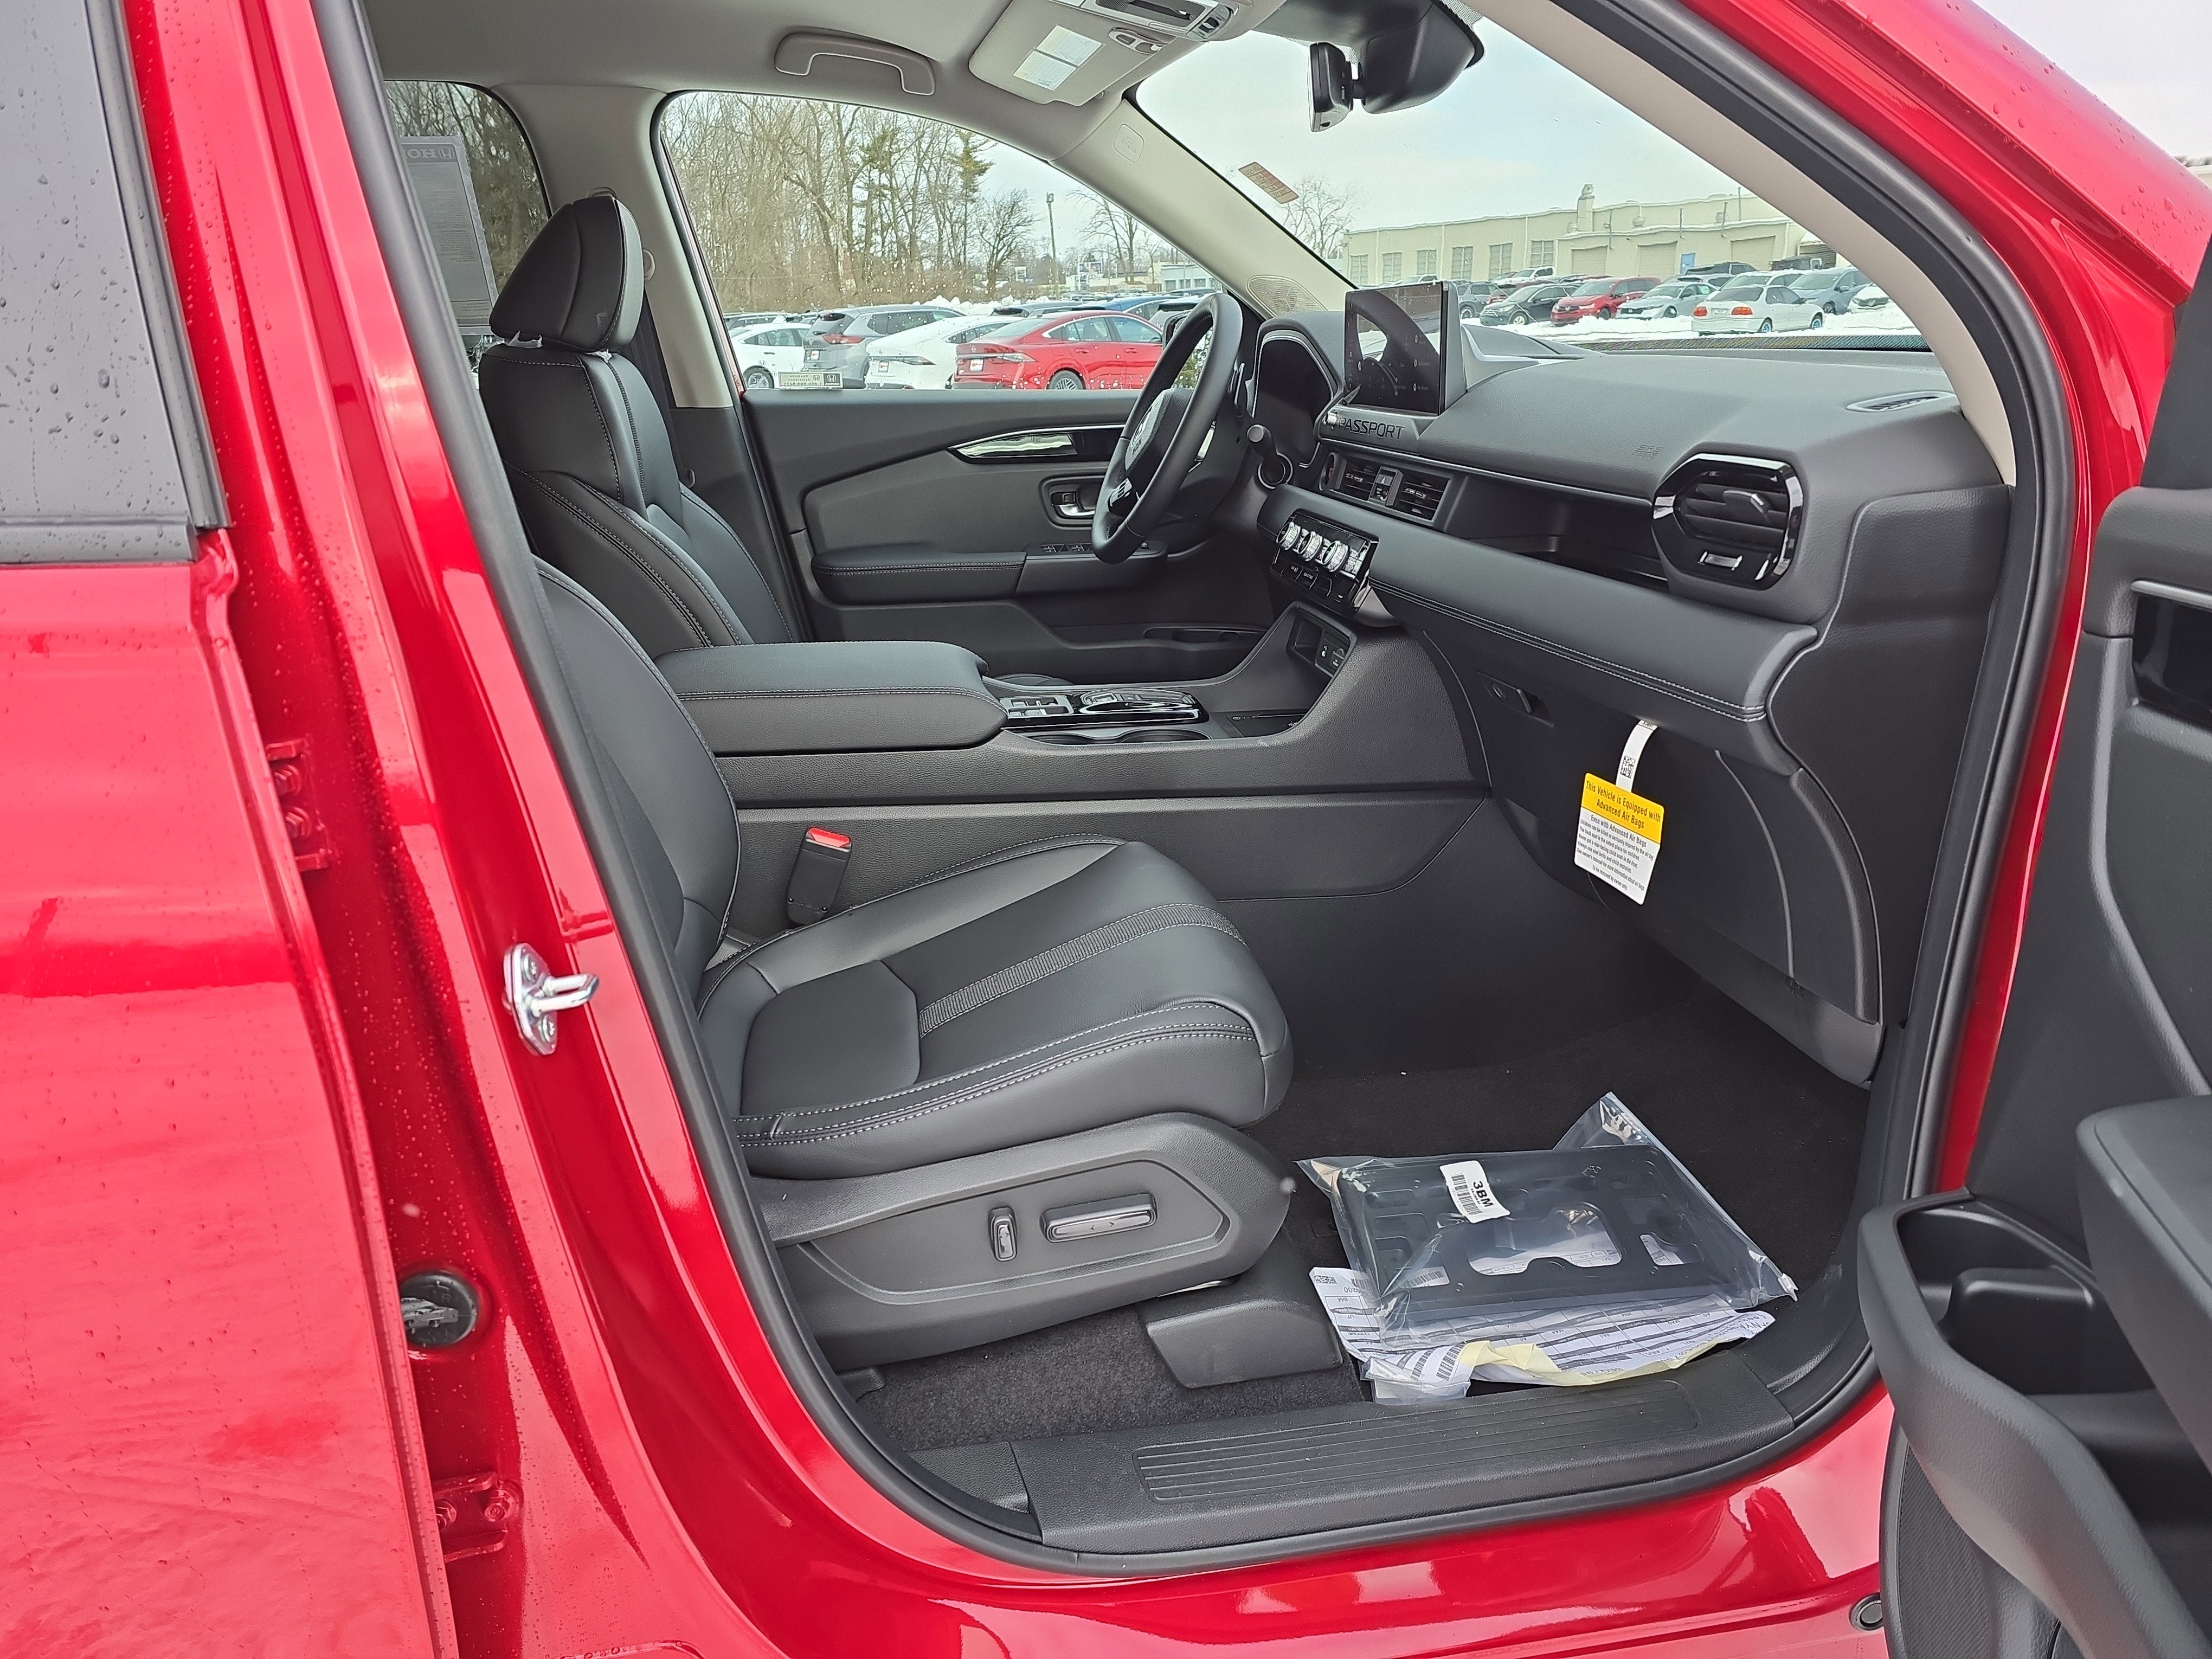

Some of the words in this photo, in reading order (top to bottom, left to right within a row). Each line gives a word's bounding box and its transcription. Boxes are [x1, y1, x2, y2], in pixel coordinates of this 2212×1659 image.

[1339, 417, 1405, 440] PASSPORT
[1585, 780, 1596, 792] This
[1597, 785, 1616, 801] Vehicle
[1616, 794, 1622, 805] is
[1622, 798, 1647, 816] Equipped
[1648, 808, 1661, 822] with
[1596, 798, 1621, 817] Advanced
[1622, 810, 1630, 822] Air
[1631, 814, 1644, 829] Bags
[1591, 814, 1600, 824] Even
[1600, 819, 1609, 828] with
[1609, 824, 1629, 839] Advanced
[1635, 837, 1647, 847] Bags
[1473, 1180, 1494, 1207] 3BM
